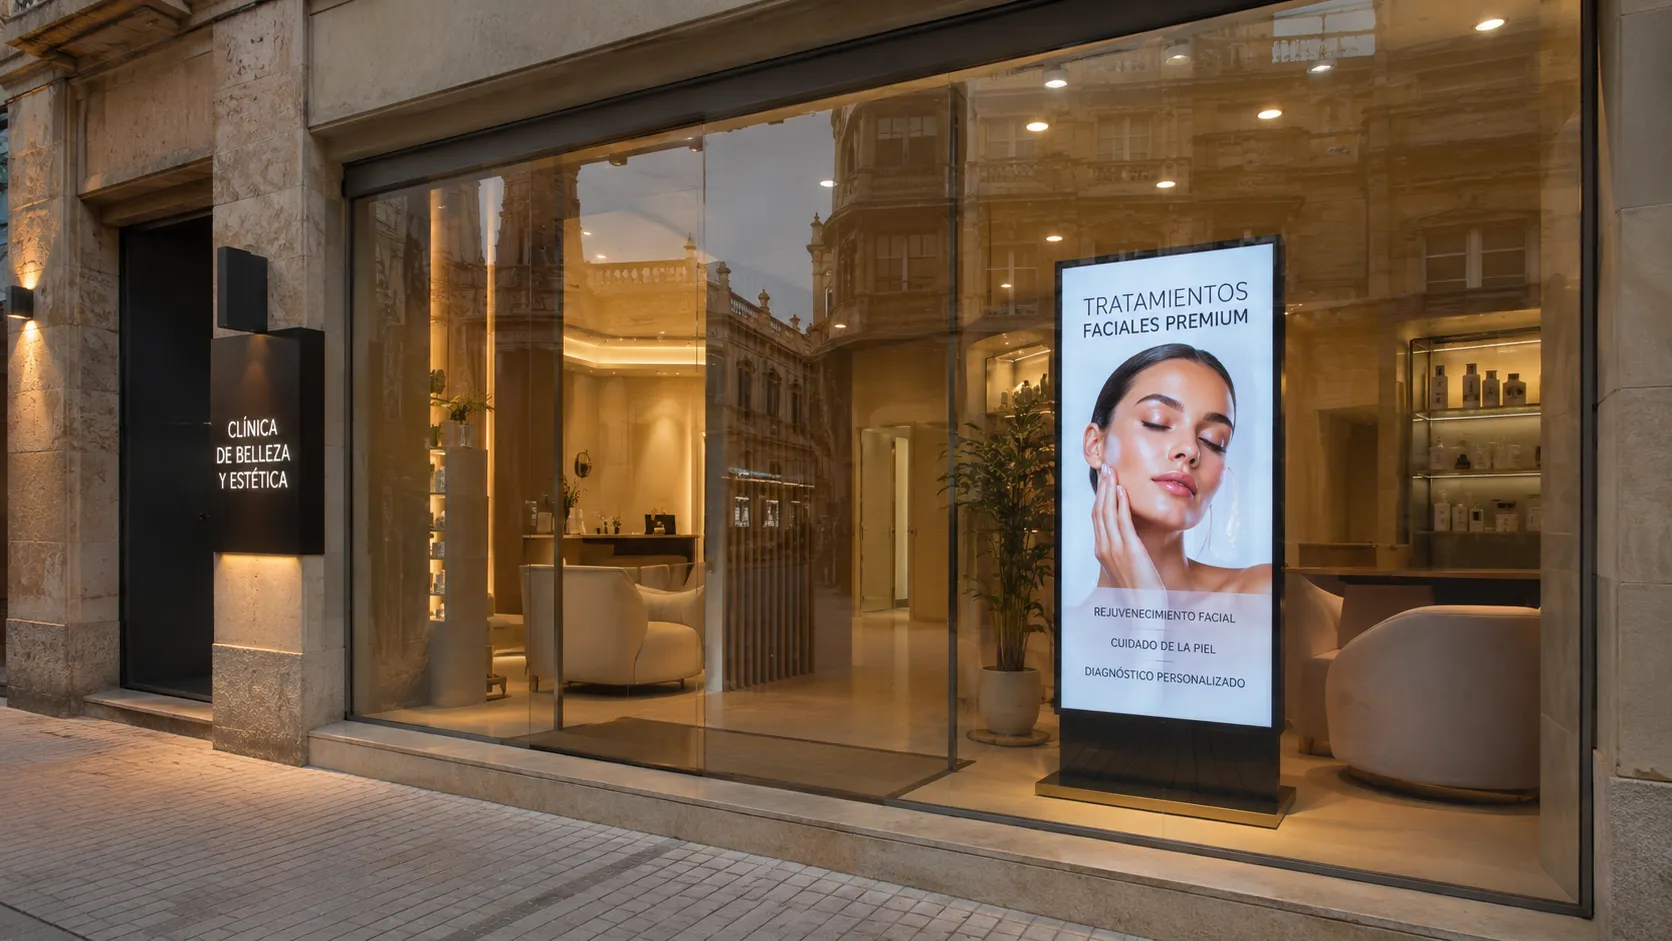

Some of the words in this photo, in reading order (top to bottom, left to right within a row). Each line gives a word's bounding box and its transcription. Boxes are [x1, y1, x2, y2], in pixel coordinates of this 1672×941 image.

[1083, 281, 1248, 316] TRATAMIENTOS
[1083, 317, 1160, 338] FACIALES
[1166, 308, 1248, 331] PREMIUM
[228, 416, 278, 438] CLÍNICA
[216, 446, 232, 464] DE
[236, 444, 291, 463] BELLEZA
[219, 472, 227, 489] Y
[230, 467, 288, 489] ESTÉTICA
[1094, 607, 1196, 621] REJUVENECIMIENTO
[1199, 612, 1236, 623] FACIAL
[1111, 638, 1158, 651] CUIDADO
[1161, 641, 1174, 651] DE
[1177, 642, 1191, 652] LA
[1194, 643, 1216, 654] PIEL
[1085, 666, 1154, 681] DIAGNÓSTICO
[1157, 672, 1246, 688] PERSONALIZADO
